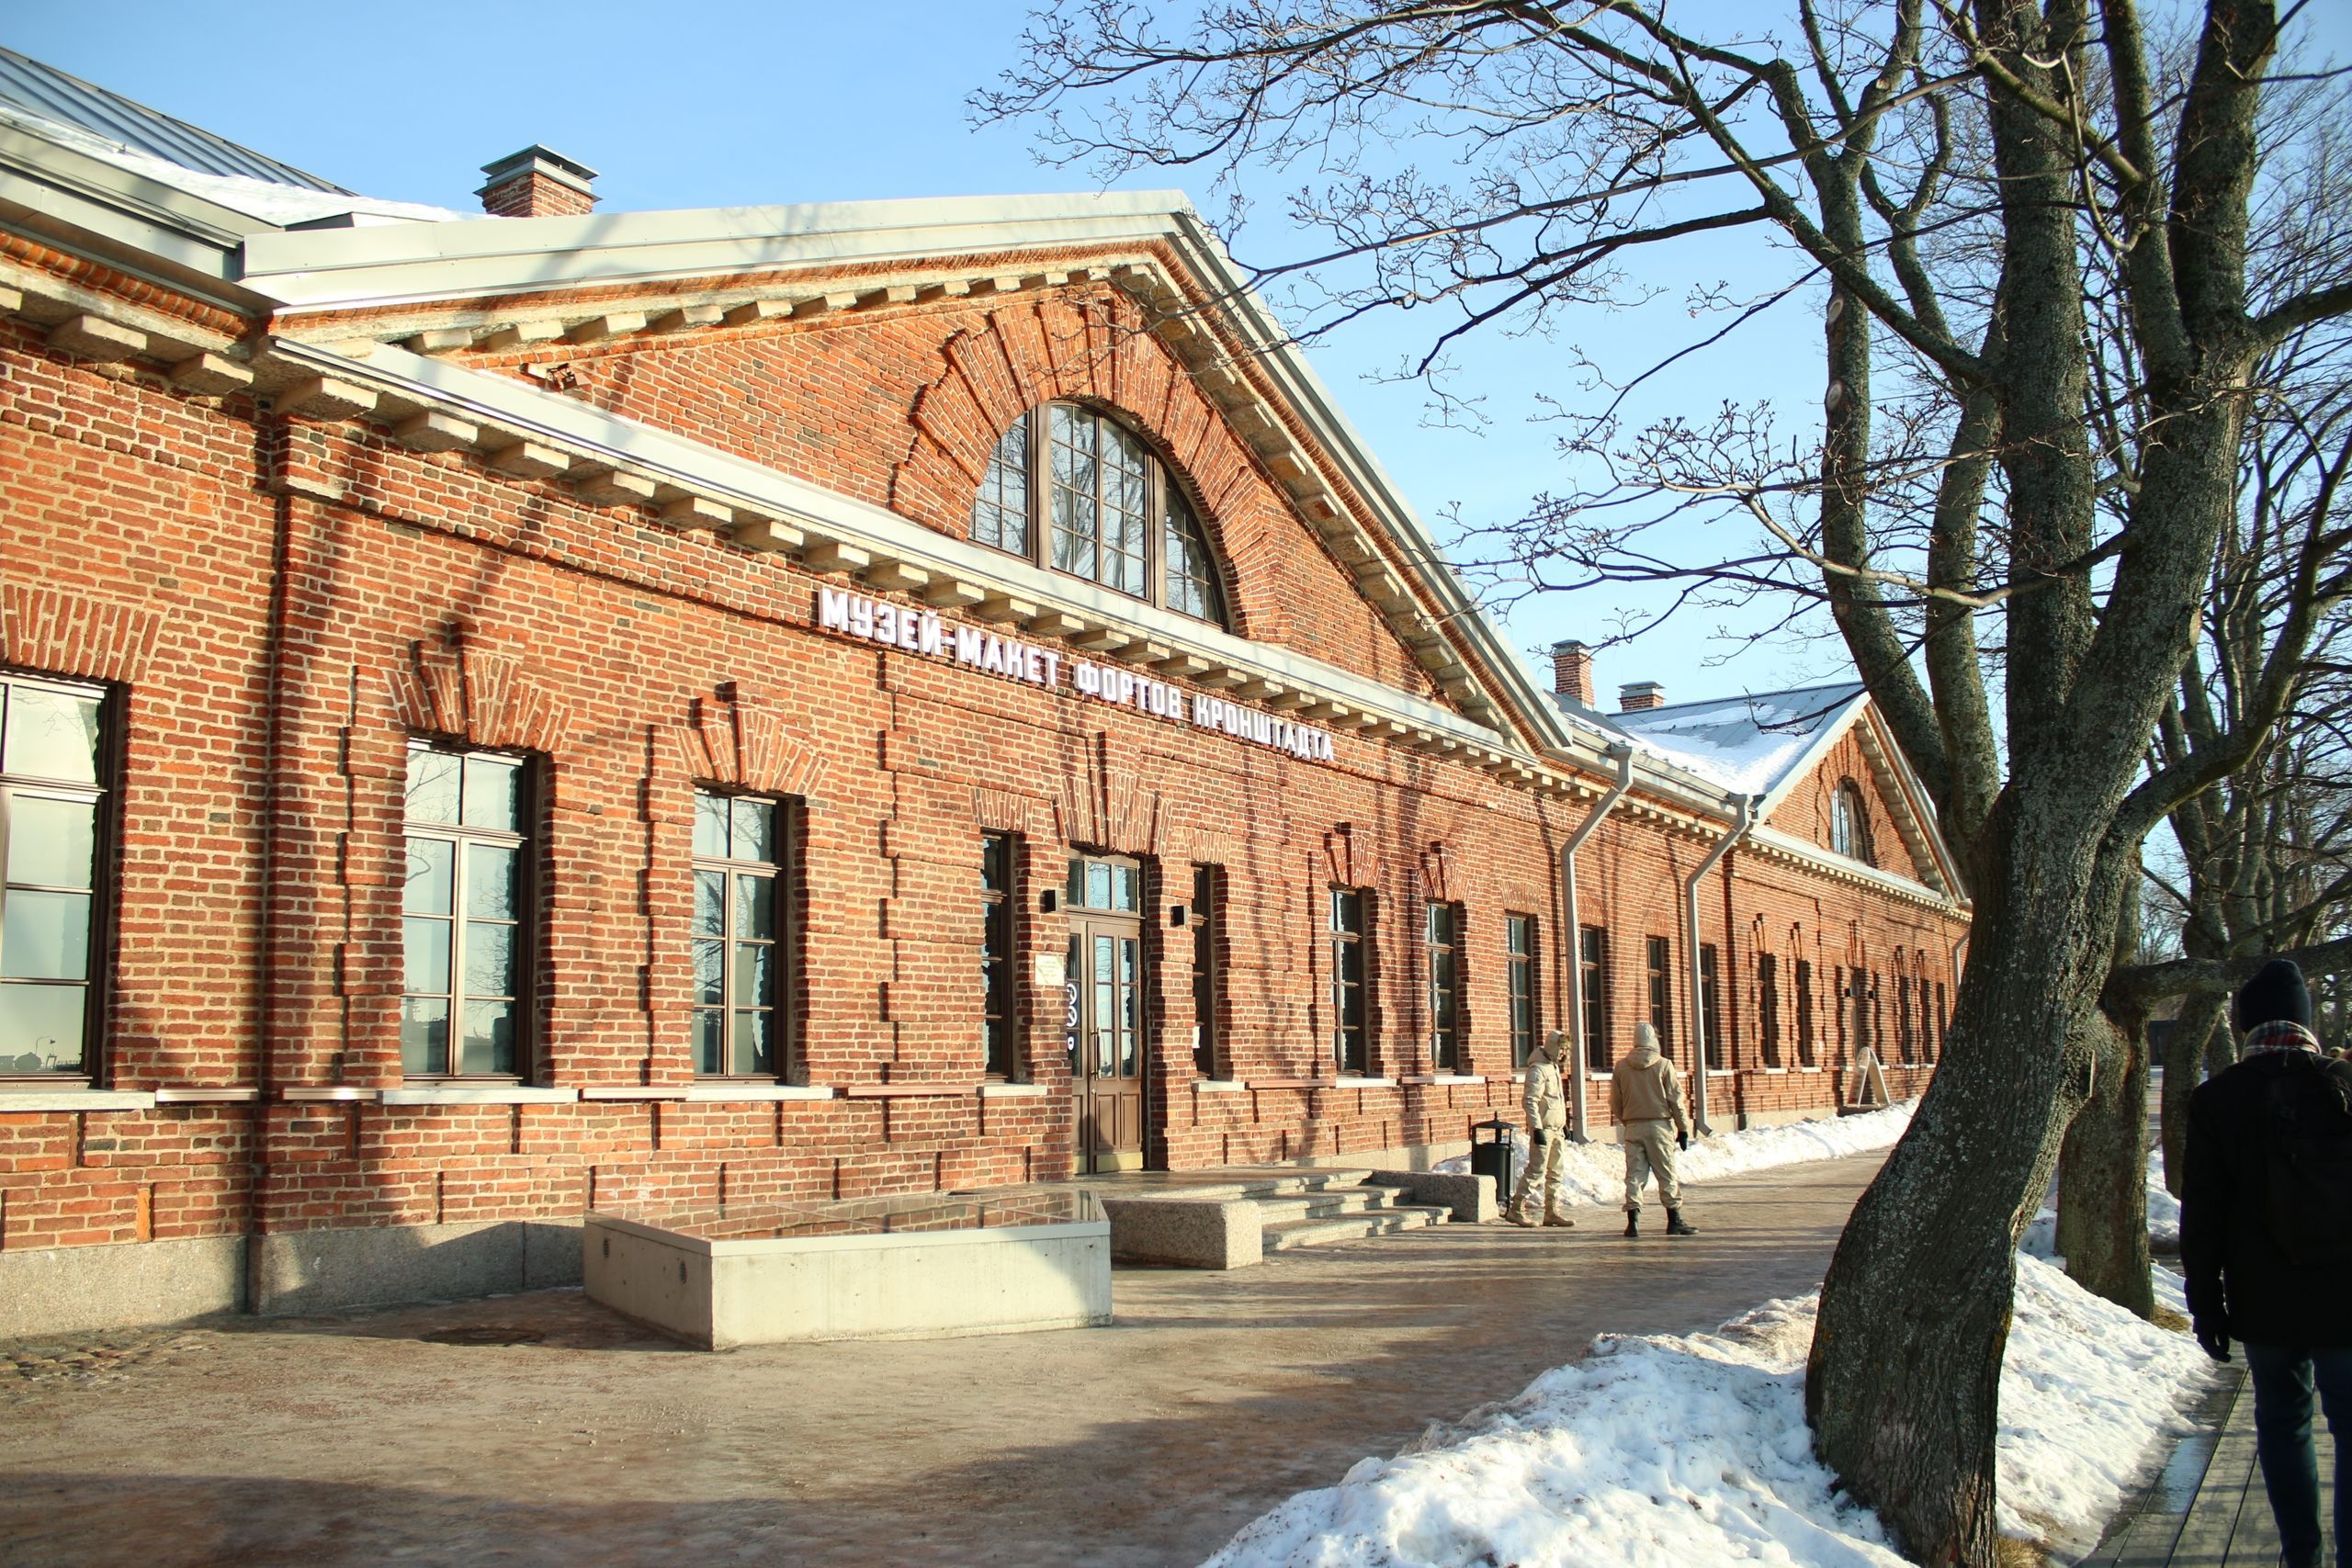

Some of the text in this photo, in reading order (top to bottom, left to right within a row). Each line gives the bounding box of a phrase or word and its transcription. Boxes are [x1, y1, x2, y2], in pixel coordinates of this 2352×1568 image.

[819, 587, 1334, 761] МУЗЕЙ-МАКЕТ ФОРТОВ КРОНШТАДТА
